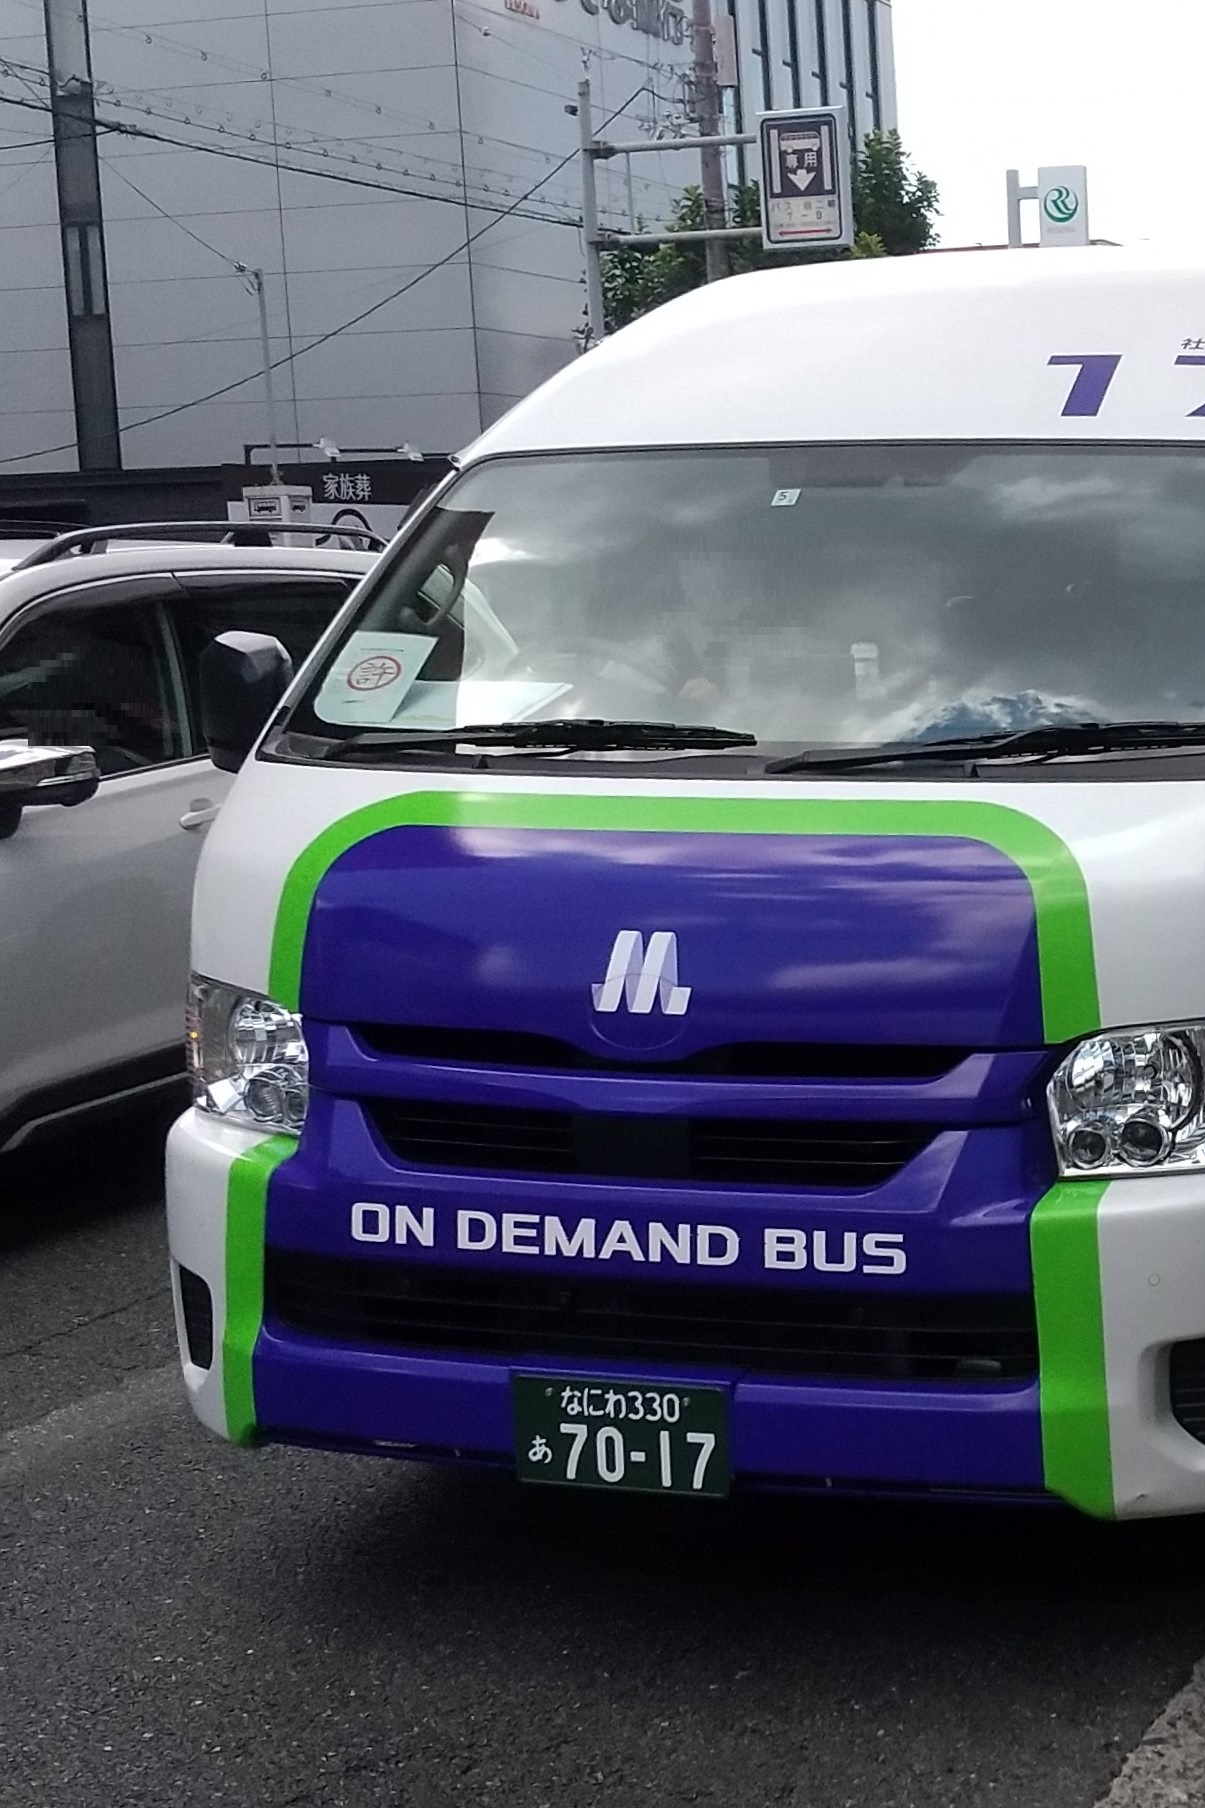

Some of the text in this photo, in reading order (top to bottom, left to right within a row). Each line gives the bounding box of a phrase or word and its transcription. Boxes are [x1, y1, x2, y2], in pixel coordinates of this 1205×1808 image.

[322, 472, 373, 501] 家族葬
[350, 1201, 908, 1276] ON DEMAND BUS
[527, 1422, 717, 1490] あ 70-17
